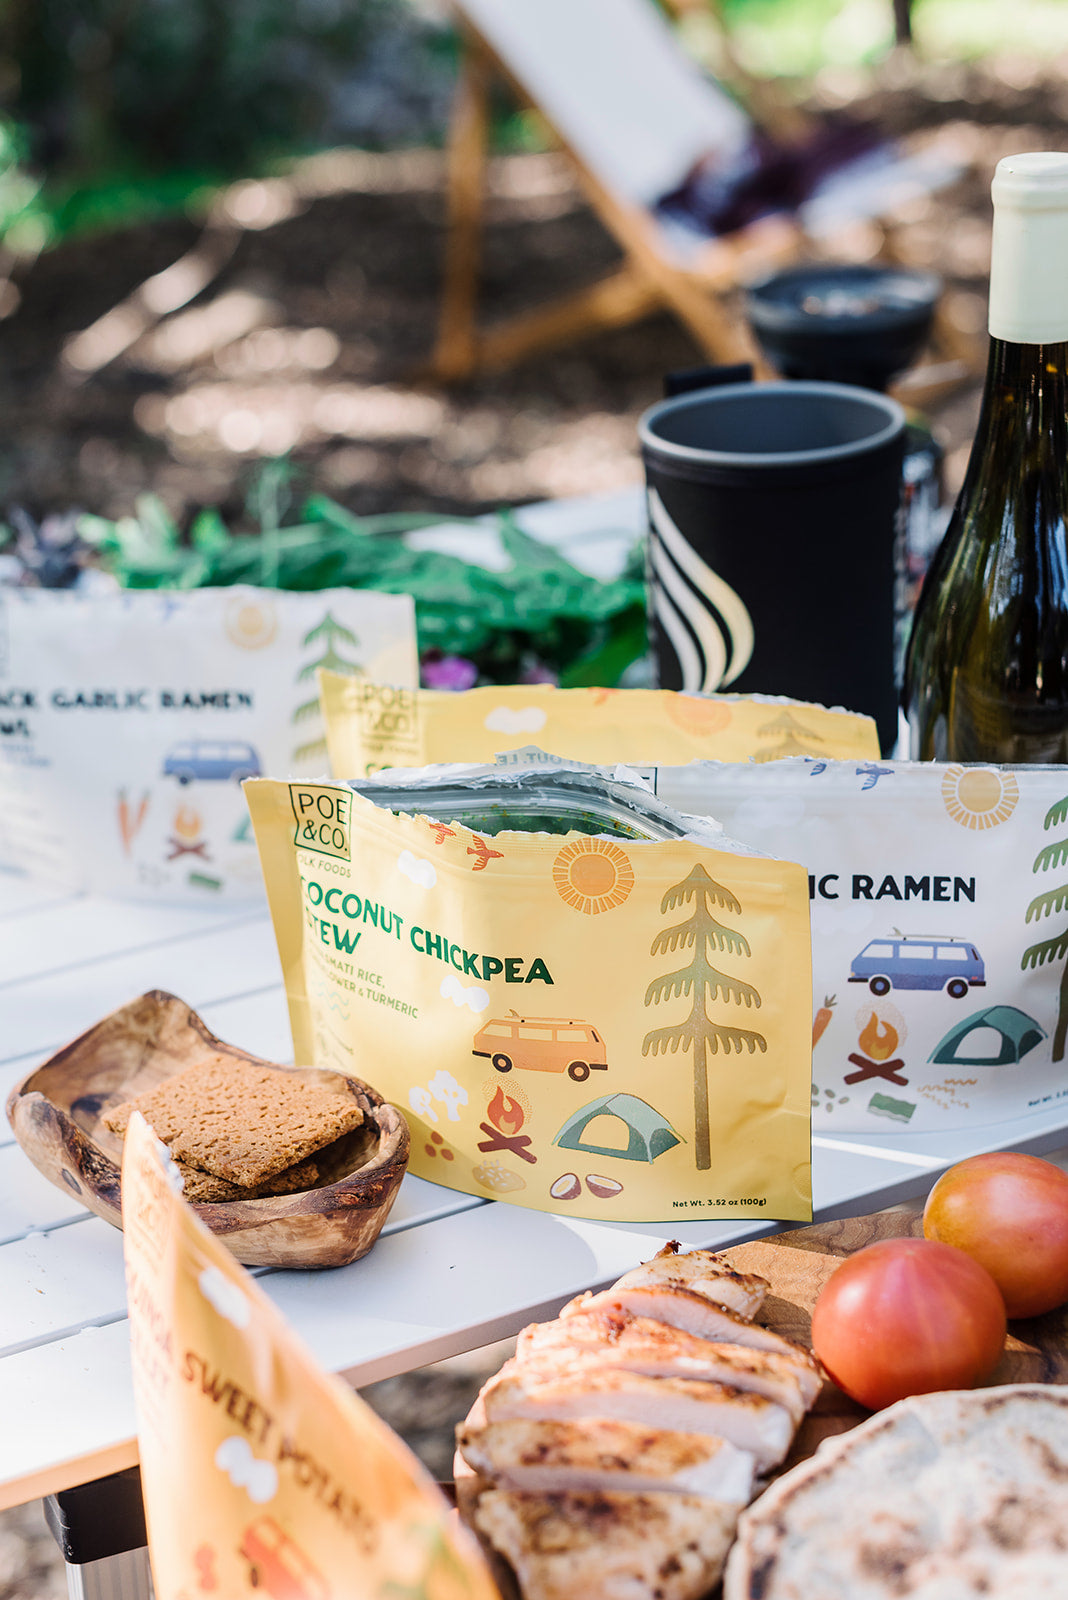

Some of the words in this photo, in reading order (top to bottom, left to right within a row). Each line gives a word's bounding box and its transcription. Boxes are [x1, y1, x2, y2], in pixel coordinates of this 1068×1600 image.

[51, 690, 149, 710] GARLIC
[161, 689, 253, 710] RAMEN
[298, 793, 347, 825] POE
[303, 819, 348, 851] &CO.
[318, 860, 352, 878] FOODS
[852, 874, 976, 902] RAMEN
[301, 876, 403, 940] OCONUT
[410, 926, 555, 985] CHICKPEA
[306, 907, 362, 954] TEW
[366, 988, 419, 1019] TURMERIC
[740, 1198, 767, 1207] (100g)
[182, 1350, 273, 1442] SWEET
